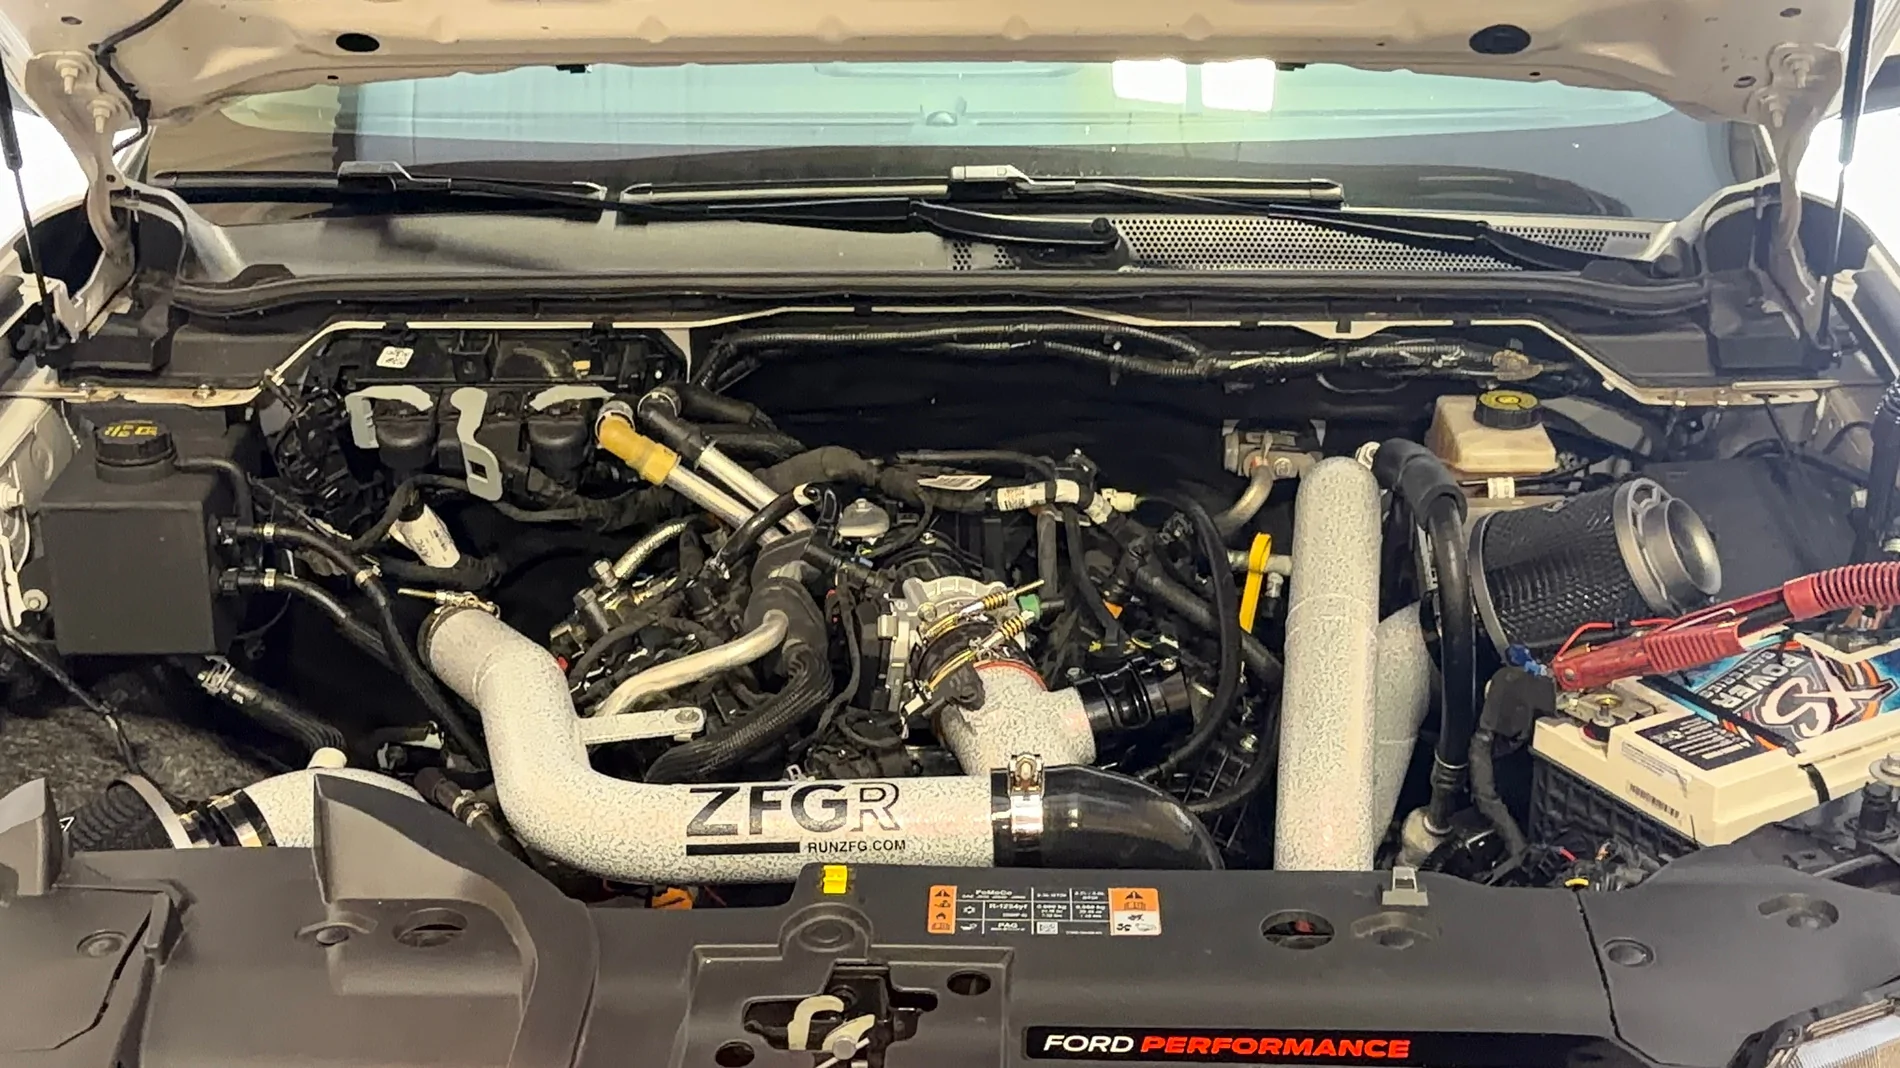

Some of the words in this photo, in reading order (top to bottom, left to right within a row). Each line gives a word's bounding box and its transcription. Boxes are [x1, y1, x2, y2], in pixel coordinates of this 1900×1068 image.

[1711, 652, 1805, 709] POWER
[1760, 648, 1888, 738] XS
[686, 782, 901, 837] ZFGR
[807, 839, 906, 853] RUNZFG.COM
[1043, 1034, 1134, 1053] FORD
[1139, 1036, 1411, 1059] PERFORMANCE
